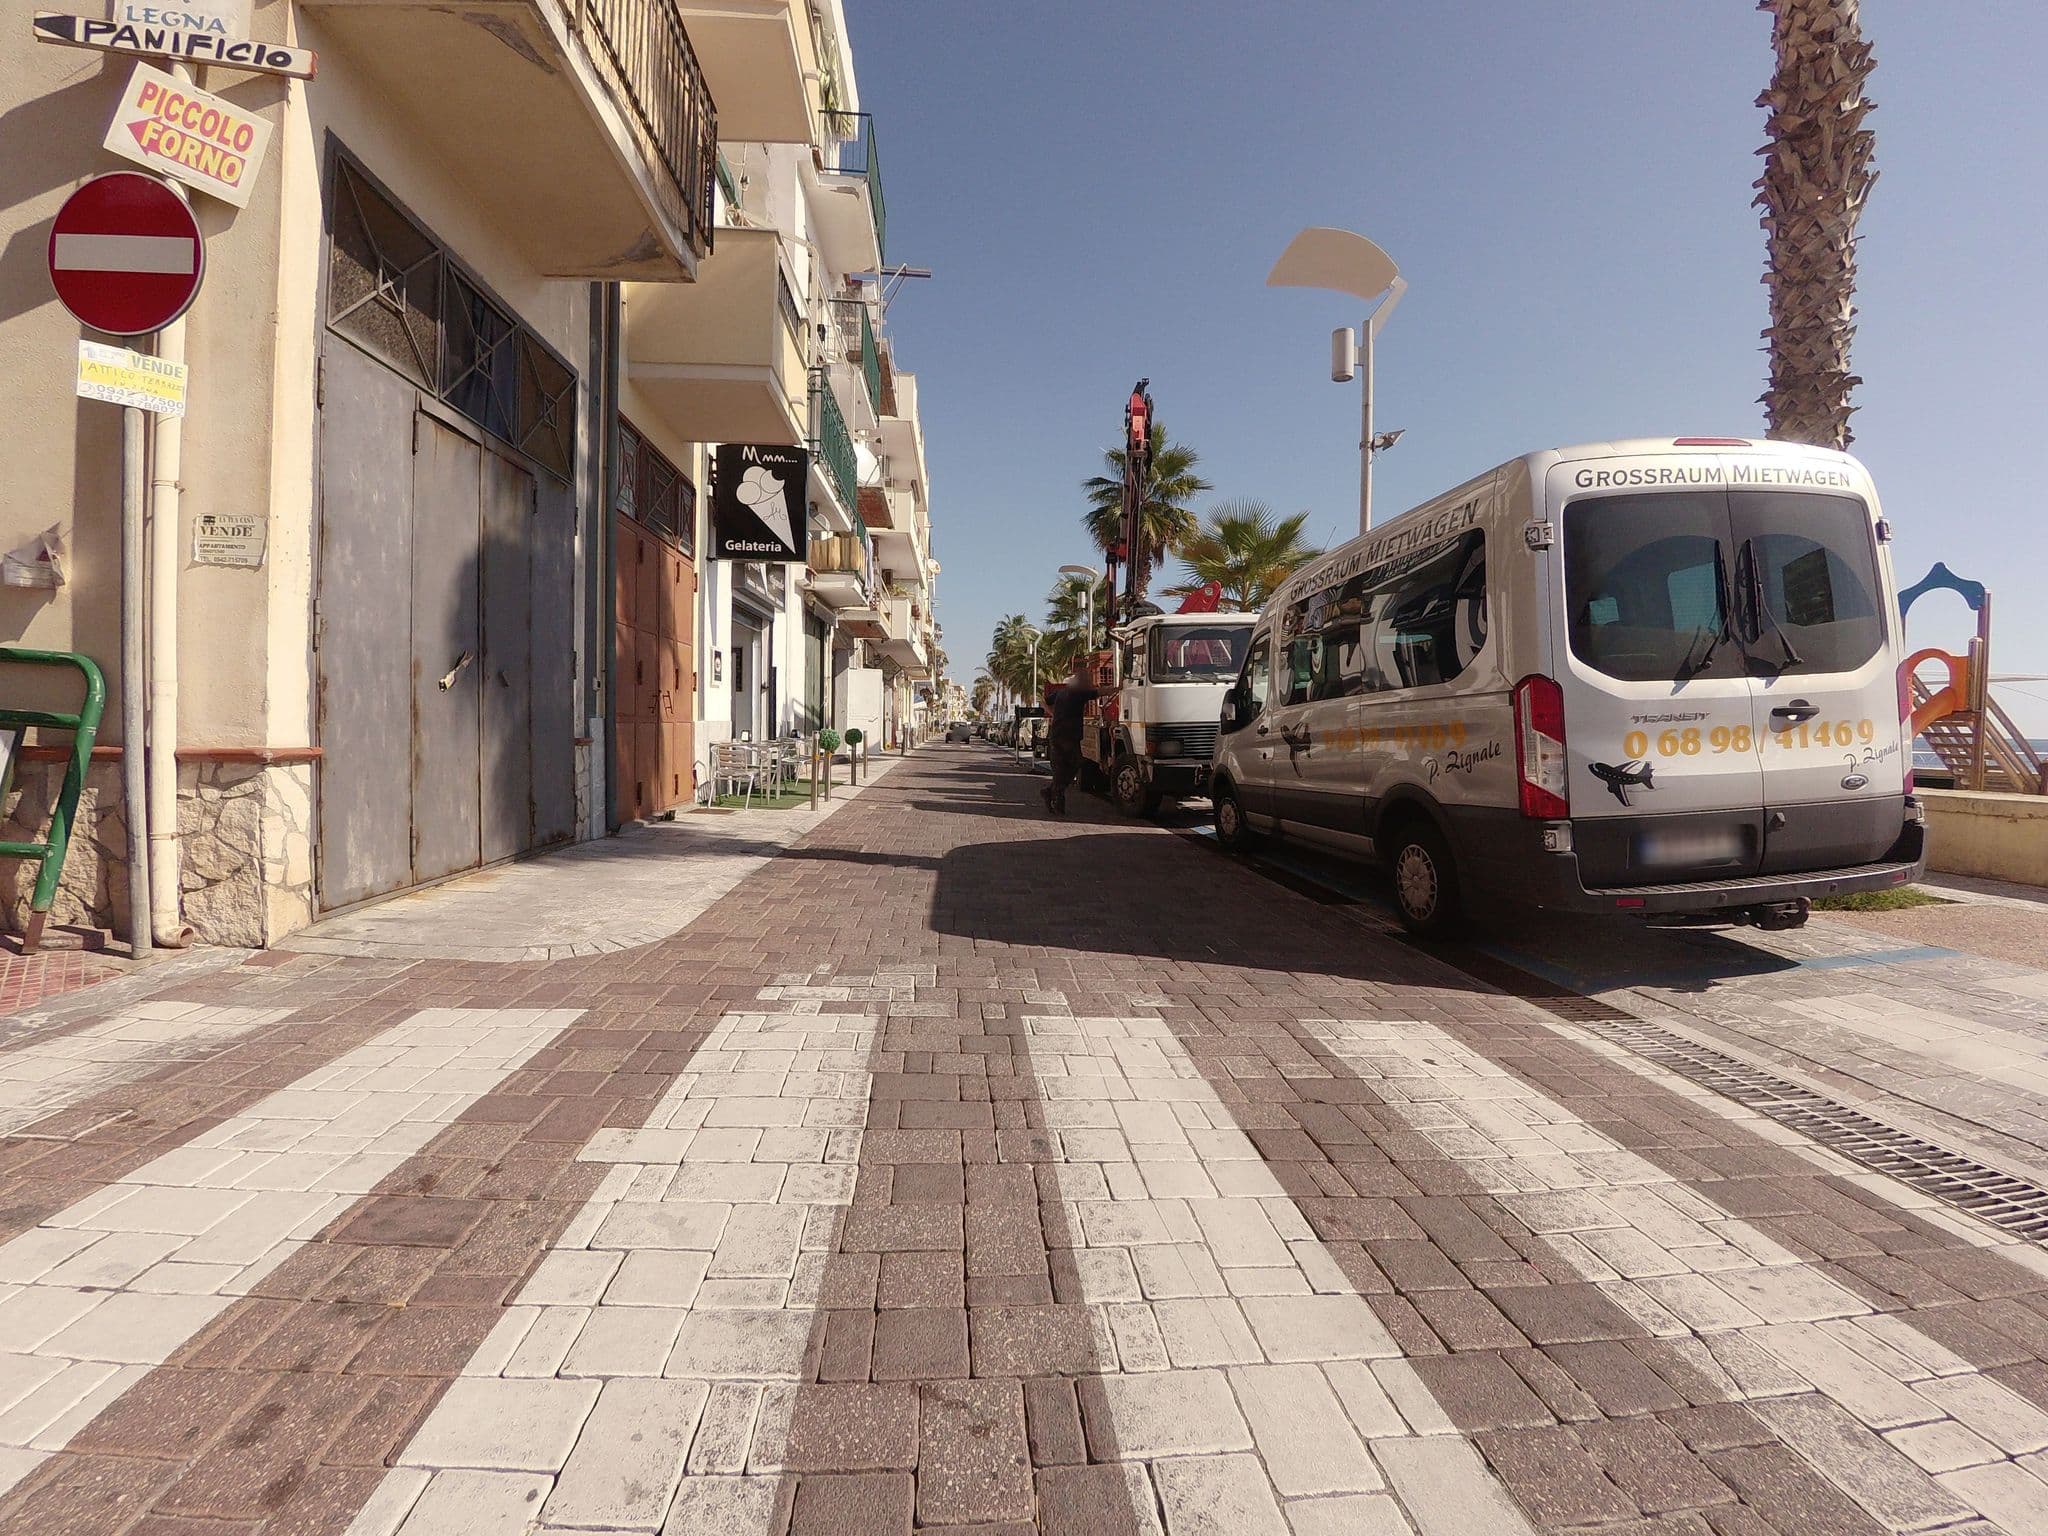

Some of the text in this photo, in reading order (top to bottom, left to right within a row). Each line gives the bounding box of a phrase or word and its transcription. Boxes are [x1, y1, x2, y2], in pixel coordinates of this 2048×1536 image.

[126, 5, 227, 34] LEGNA
[84, 19, 293, 68] PANIFICIO
[136, 80, 255, 153] PICCOLO
[140, 119, 245, 184] FORNO
[131, 355, 184, 379] VENDE
[1575, 464, 1851, 488] GROSSRAUM MIETWAGEN
[200, 525, 253, 537] VENDE
[725, 539, 782, 552] Gelateria
[1290, 498, 1479, 601] GROSSRAUM MIETWAGEN
[1630, 712, 1711, 724] TRANSIT
[1656, 727, 1702, 757] 68
[1709, 725, 1752, 754] 98
